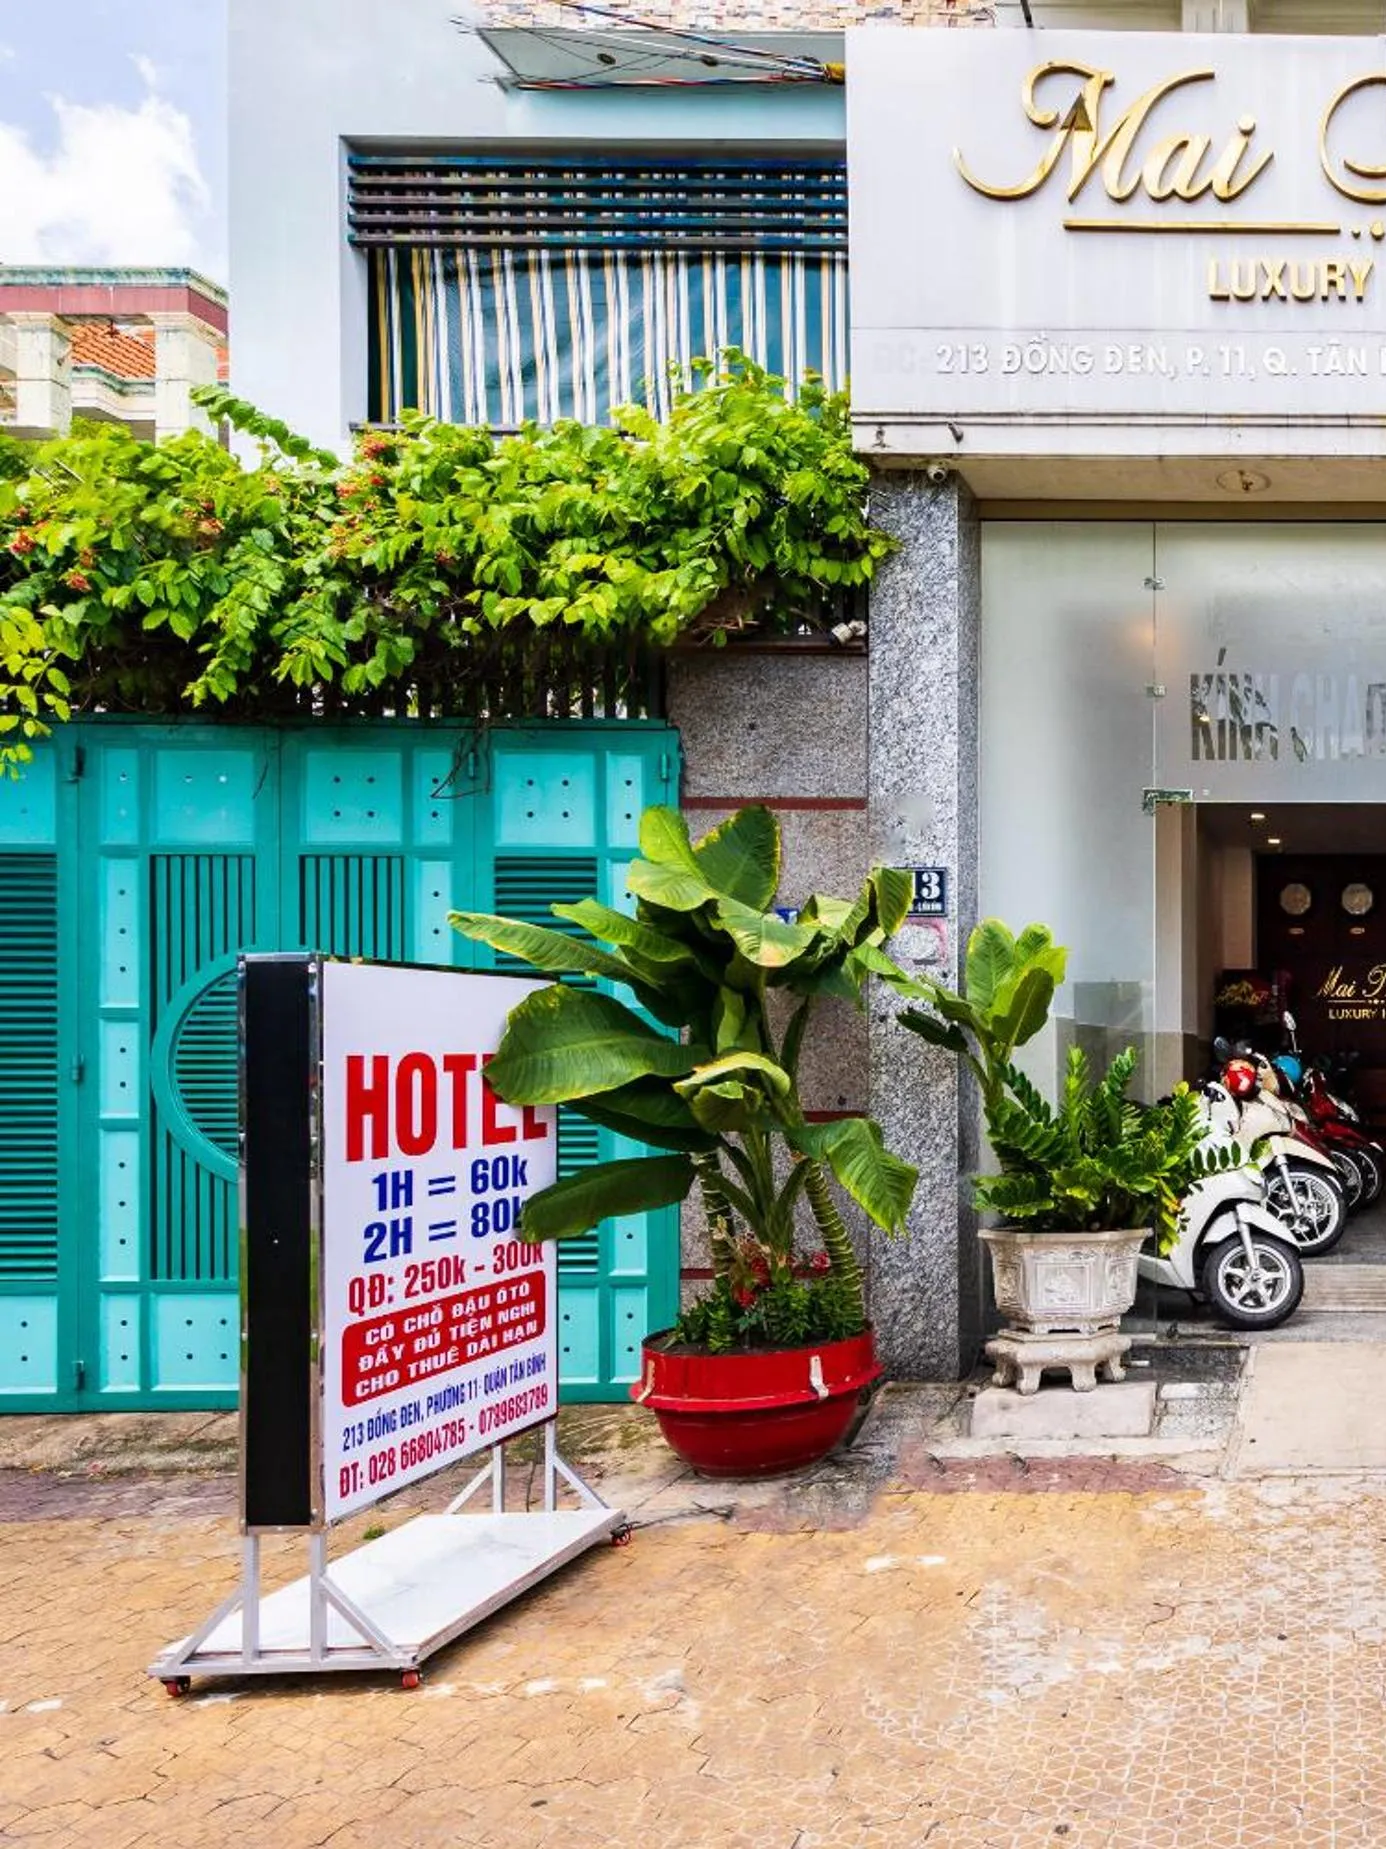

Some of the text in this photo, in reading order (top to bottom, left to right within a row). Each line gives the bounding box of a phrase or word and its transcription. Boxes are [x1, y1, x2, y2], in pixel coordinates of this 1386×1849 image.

[953, 60, 1275, 204] Mai
[1208, 259, 1375, 302] LUXURY
[936, 345, 989, 375] 213
[1262, 347, 1298, 376] Q.
[1306, 337, 1368, 376] TÂN
[1312, 965, 1357, 999] Mai
[1328, 1008, 1378, 1020] LUXURY
[371, 1169, 413, 1212] 1H
[471, 1154, 528, 1195] 60k
[363, 1216, 413, 1263] 2H
[349, 1273, 395, 1317] QĐ:
[404, 1254, 466, 1299] 250k
[497, 1300, 536, 1325] NGHI
[365, 1321, 395, 1346] CÓ
[355, 1369, 400, 1398] CHO
[407, 1346, 460, 1379] THUÊ
[502, 1319, 537, 1343] HẠN
[342, 1421, 364, 1452] 213
[369, 1447, 396, 1485] 028
